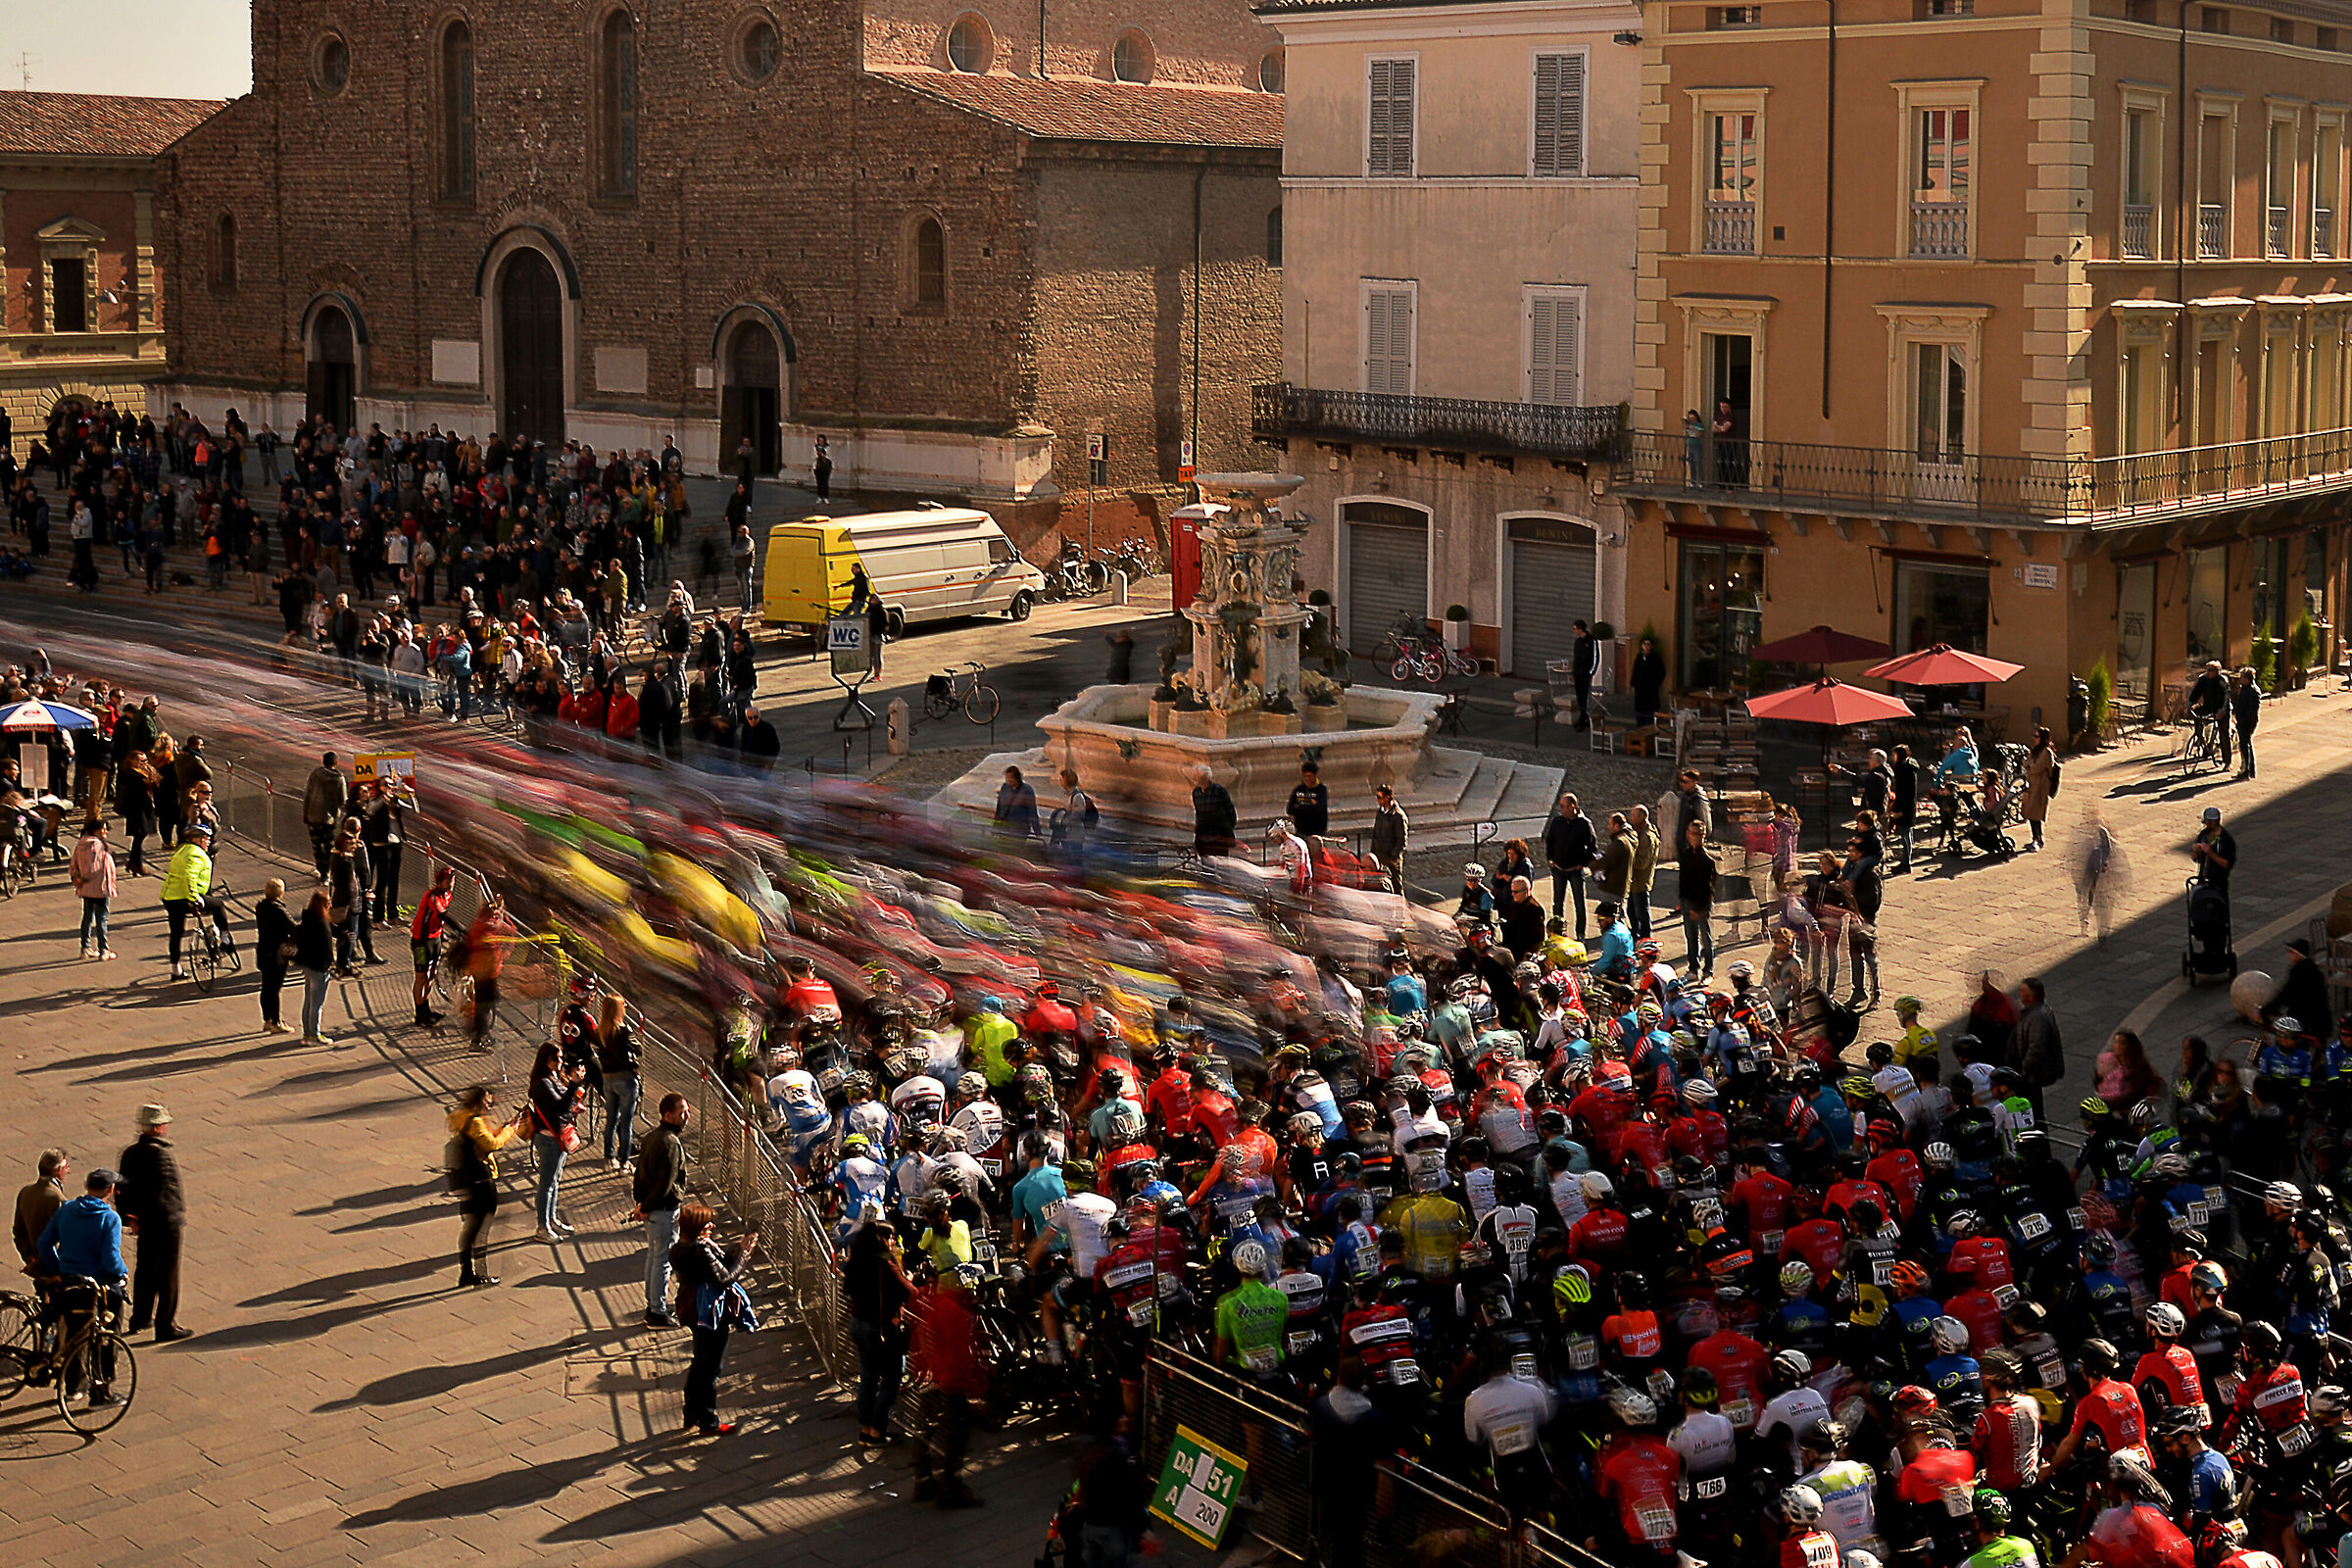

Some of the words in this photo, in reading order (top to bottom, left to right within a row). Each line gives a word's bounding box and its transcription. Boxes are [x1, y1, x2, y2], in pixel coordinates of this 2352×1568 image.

[833, 628, 860, 643] WC
[355, 764, 374, 776] DA
[1313, 1161, 1331, 1180] R
[2027, 1219, 2044, 1235] 215
[1510, 1238, 1529, 1251] 396
[1173, 1450, 1194, 1478] DA
[1207, 1466, 1234, 1498] 51
[1164, 1486, 1179, 1506] A
[1196, 1502, 1219, 1527] 200
